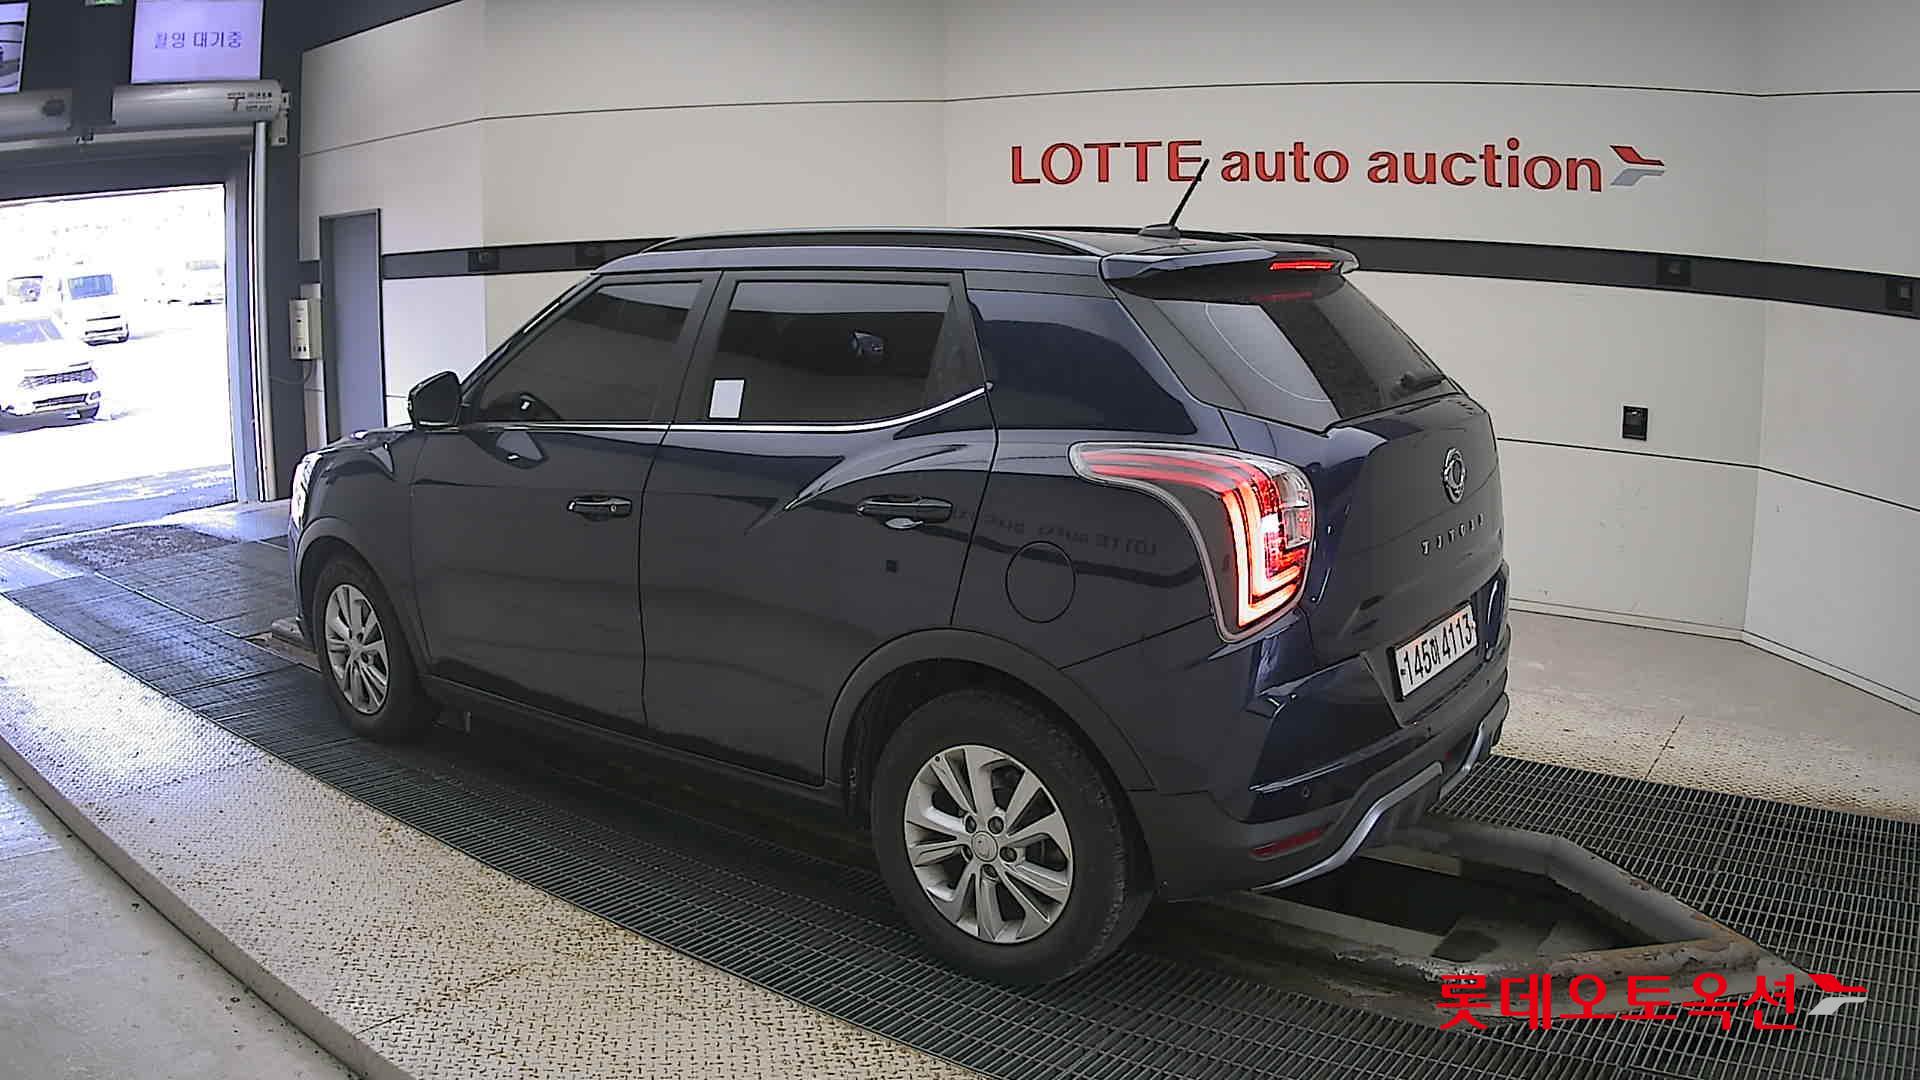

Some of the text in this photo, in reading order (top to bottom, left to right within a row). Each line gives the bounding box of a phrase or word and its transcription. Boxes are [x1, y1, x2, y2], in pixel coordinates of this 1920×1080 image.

[193, 31, 241, 49] 대기중
[1011, 138, 1602, 193] LOTTE auto auction
